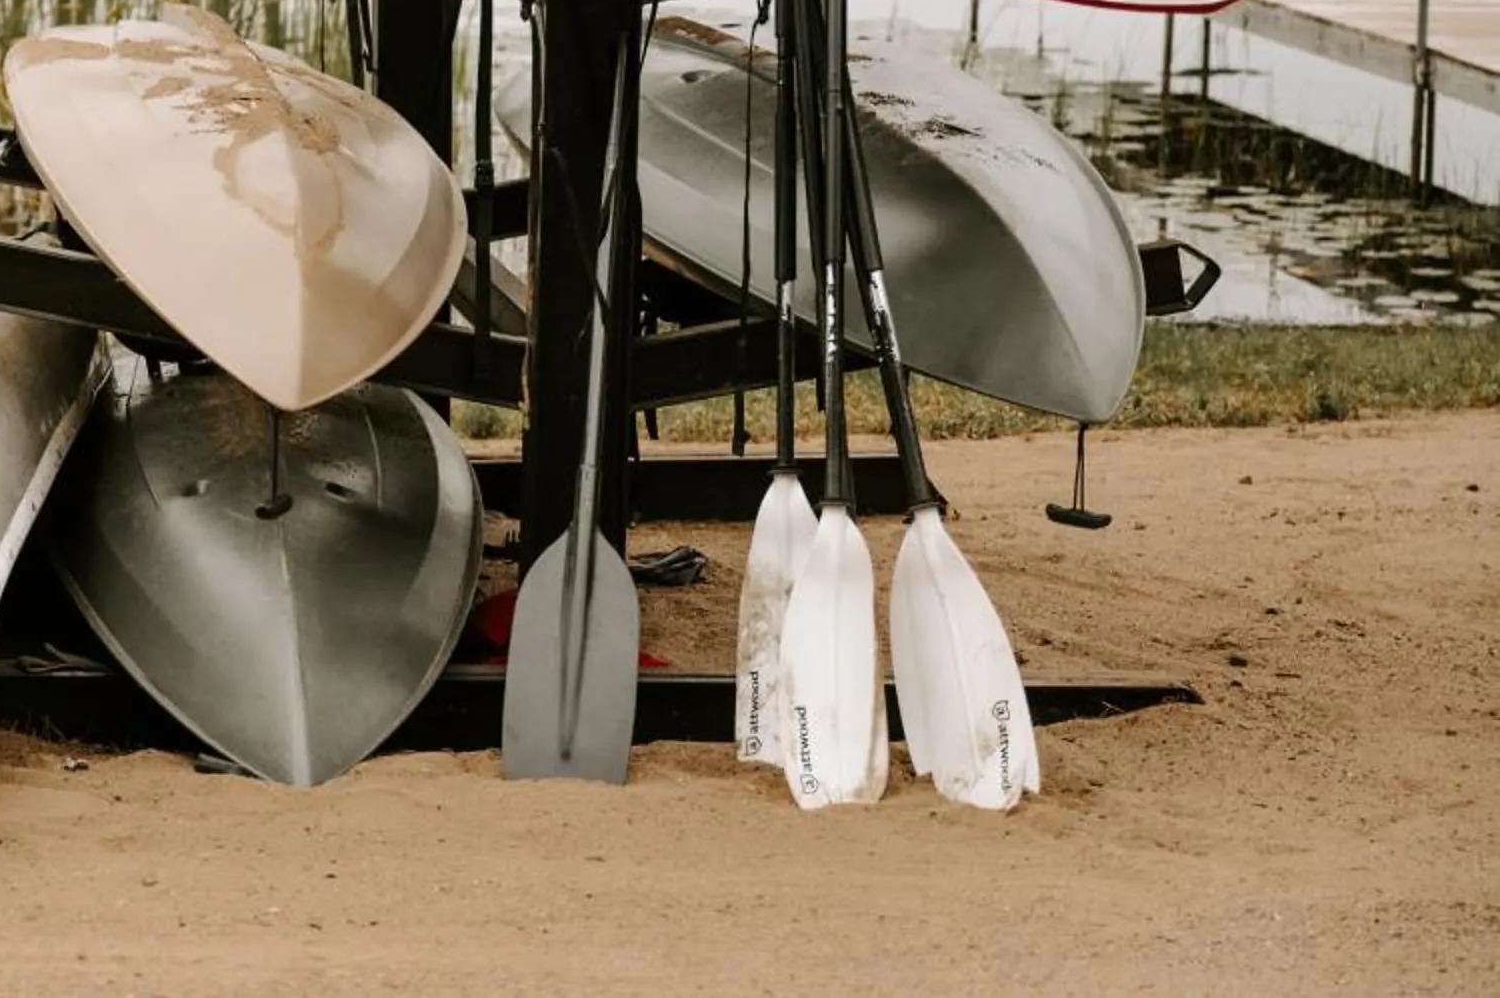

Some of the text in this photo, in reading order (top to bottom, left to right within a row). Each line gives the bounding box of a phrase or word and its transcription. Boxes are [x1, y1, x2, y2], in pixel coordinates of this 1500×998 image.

[749, 670, 760, 735] attwood
[794, 706, 813, 773] attwood
[998, 724, 1012, 791] attwood
